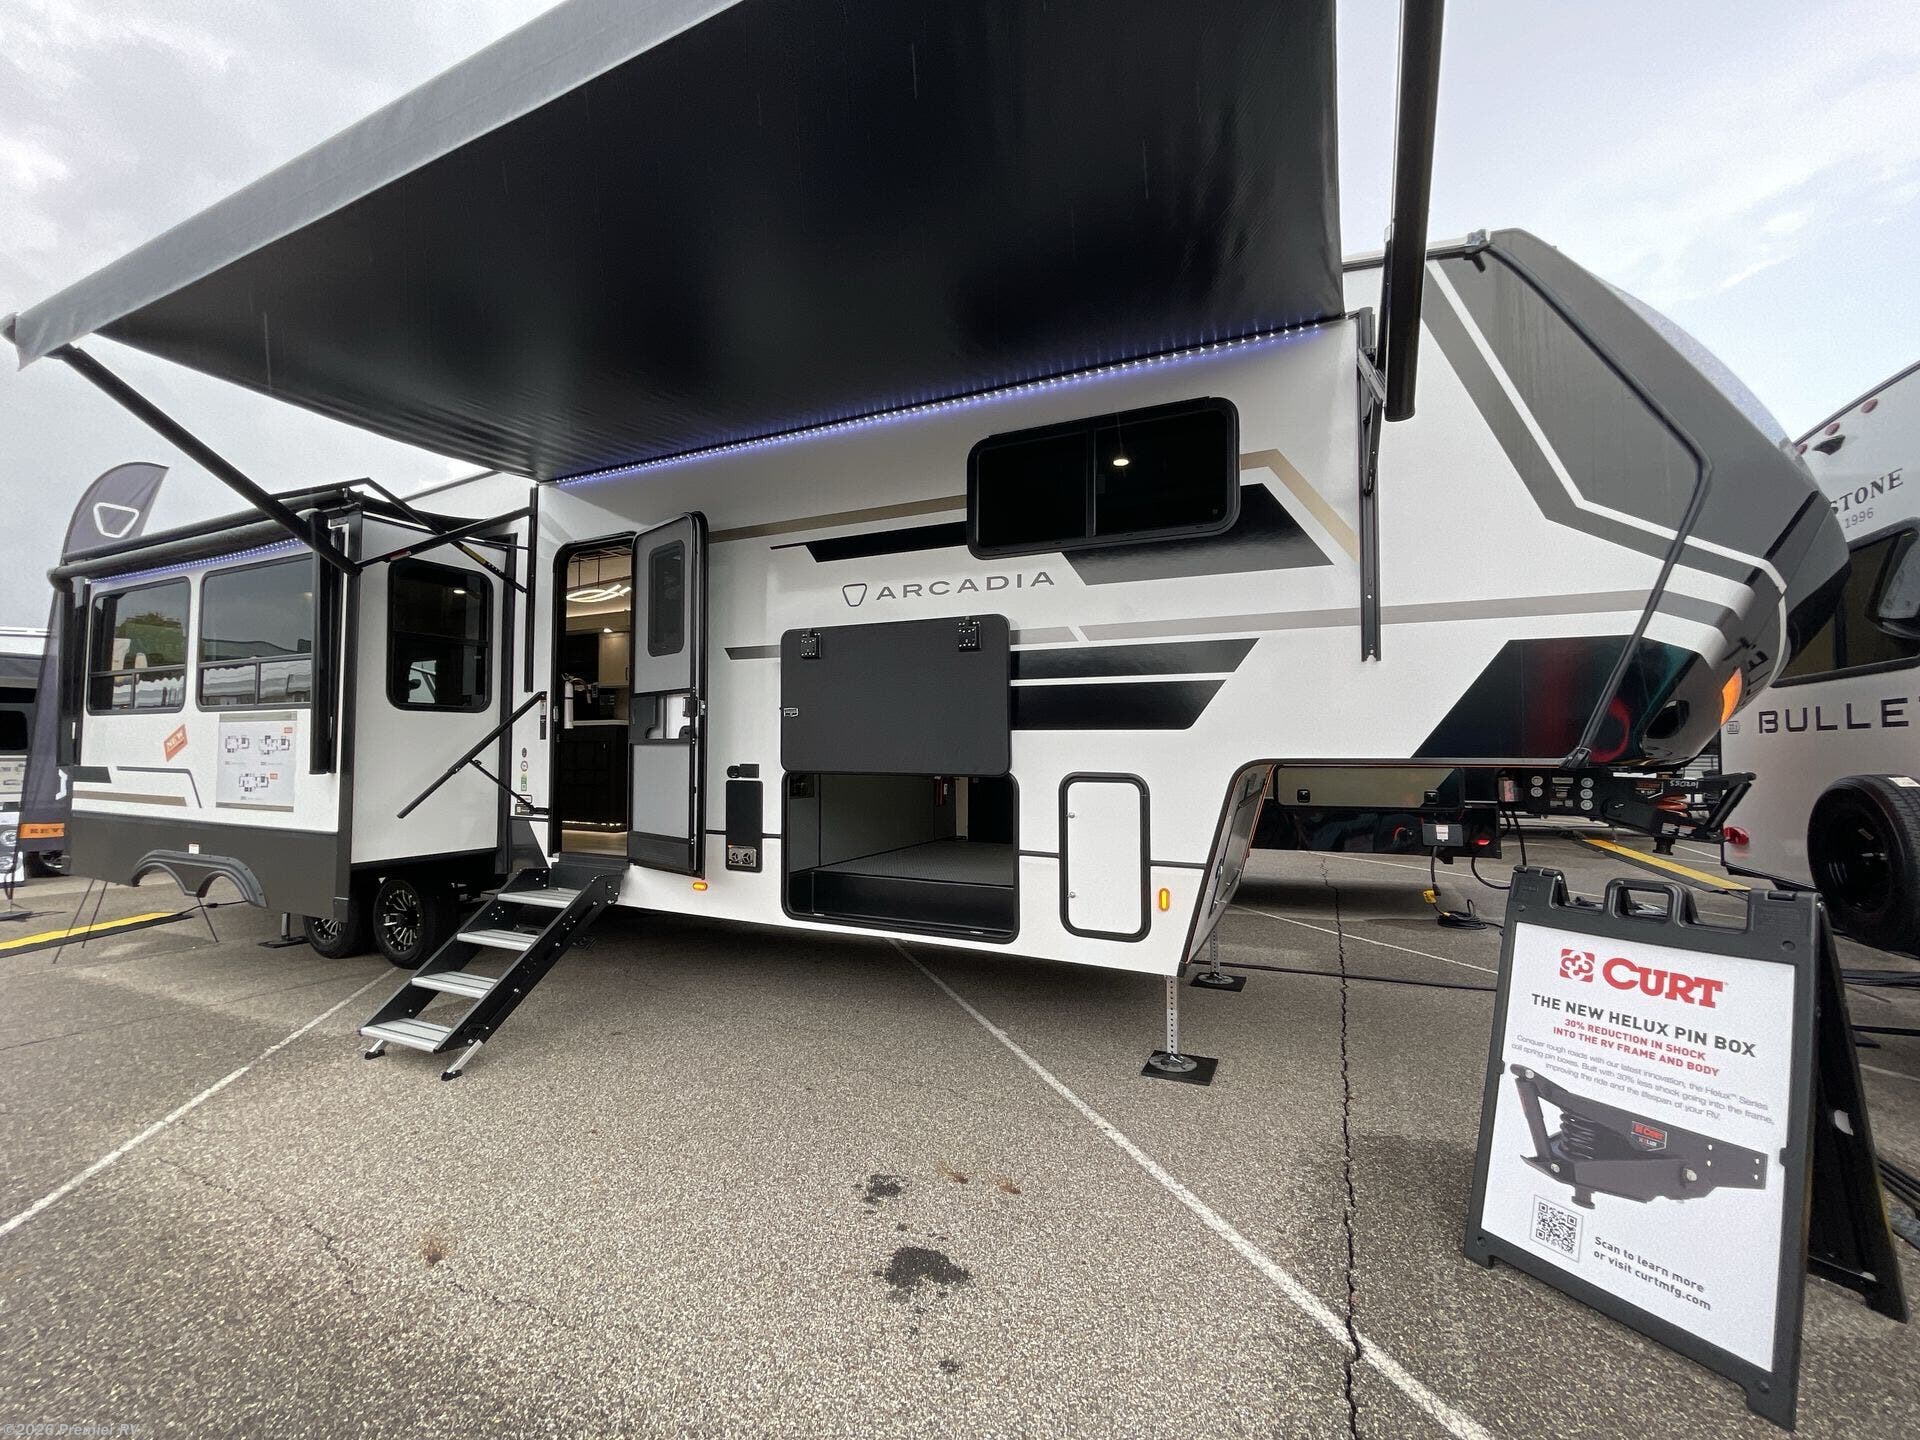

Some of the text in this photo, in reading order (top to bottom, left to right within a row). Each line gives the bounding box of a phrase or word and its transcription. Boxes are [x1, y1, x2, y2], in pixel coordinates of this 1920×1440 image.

[1845, 507, 1875, 528] 1996
[876, 571, 1055, 600] ARCADIA
[1758, 696, 1920, 734] BULLE
[1602, 957, 1723, 1009] CURT
[1532, 993, 1757, 1058] THE NEW HELUX PIN BOX
[1564, 1018, 1706, 1061] 30% REDUCTION IN SHOCK
[1516, 1034, 1546, 1048] Conquer
[1546, 1043, 1566, 1054] rough
[1567, 1048, 1588, 1060] roads
[1589, 1055, 1605, 1065] with
[1606, 1060, 1619, 1069] our
[1621, 1063, 1642, 1076] latest
[1689, 1082, 1703, 1093] the
[1739, 1096, 1769, 1111] Series
[1553, 1026, 1720, 1077] INTO THE RV FRAME AND BODY
[1511, 1042, 1523, 1051] coil
[1523, 1046, 1543, 1059] spring
[1544, 1052, 1556, 1062] pin
[1599, 1068, 1615, 1078] with
[1616, 1073, 1635, 1084] 30%
[1637, 1078, 1653, 1090] less
[1655, 1084, 1680, 1098] shock
[1681, 1092, 1707, 1107] going
[1708, 1100, 1726, 1111] into
[1727, 1105, 1743, 1116] the
[1580, 1072, 1593, 1081] the
[1594, 1076, 1608, 1087] ride
[1609, 1081, 1625, 1092] and
[1626, 1084, 1639, 1096] the
[1684, 1103, 1704, 1116] your
[1593, 1250, 1712, 1311] or visit curtmfg.com
[1594, 1236, 1705, 1293] Scan to learn more
